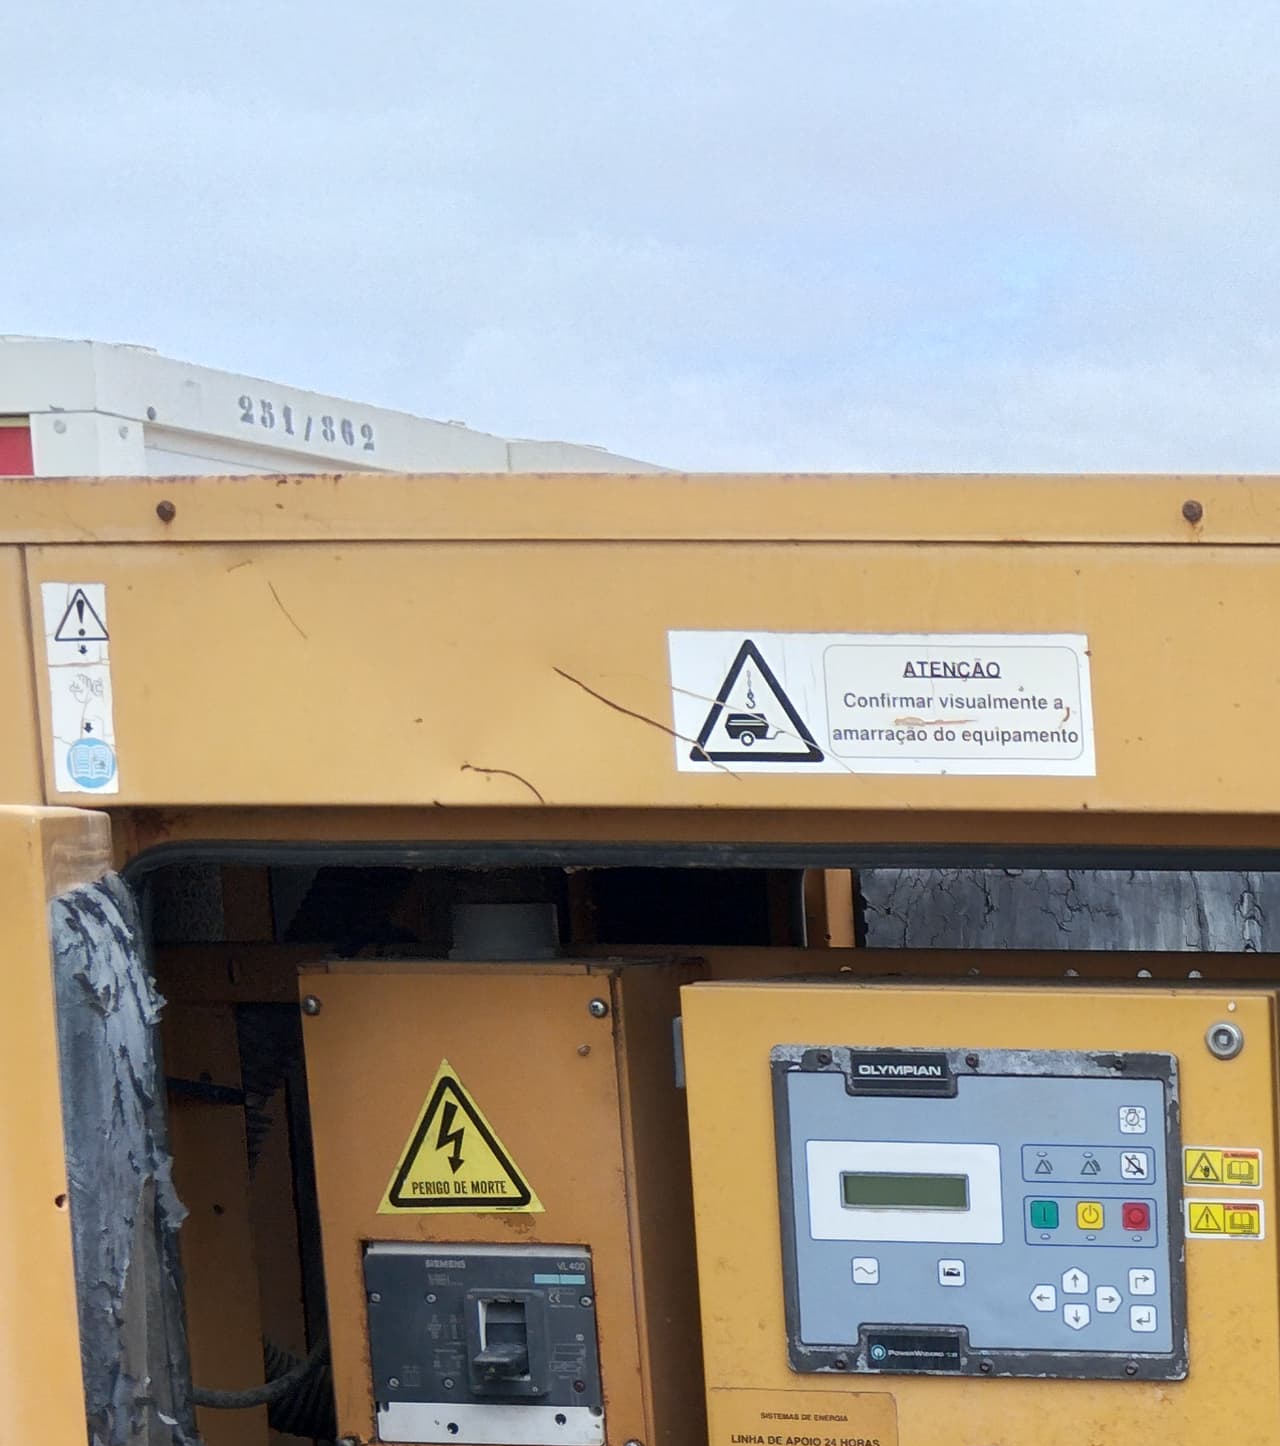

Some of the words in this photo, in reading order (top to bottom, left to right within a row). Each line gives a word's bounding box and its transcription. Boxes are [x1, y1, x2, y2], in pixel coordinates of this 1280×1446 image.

[903, 658, 1002, 682] ATENÇÃO
[843, 692, 934, 709] Confirmar
[939, 693, 1048, 710] visualmente
[1054, 697, 1064, 710] a
[832, 727, 928, 745] amarração
[933, 726, 956, 743] do
[961, 727, 1079, 746] equipamento
[858, 1064, 942, 1076] OLYMPIAN
[411, 1180, 450, 1195] PERIGO
[453, 1180, 468, 1194] DE
[471, 1180, 507, 1194] MORTE
[425, 1259, 466, 1269] SIEMENS
[760, 1412, 799, 1420] SISTEMAS
[814, 1414, 849, 1422] ENERGIA
[731, 1434, 765, 1445] LINHA
[767, 1435, 783, 1445] DE
[786, 1436, 822, 1446] APOIO
[825, 1438, 837, 1446] 24
